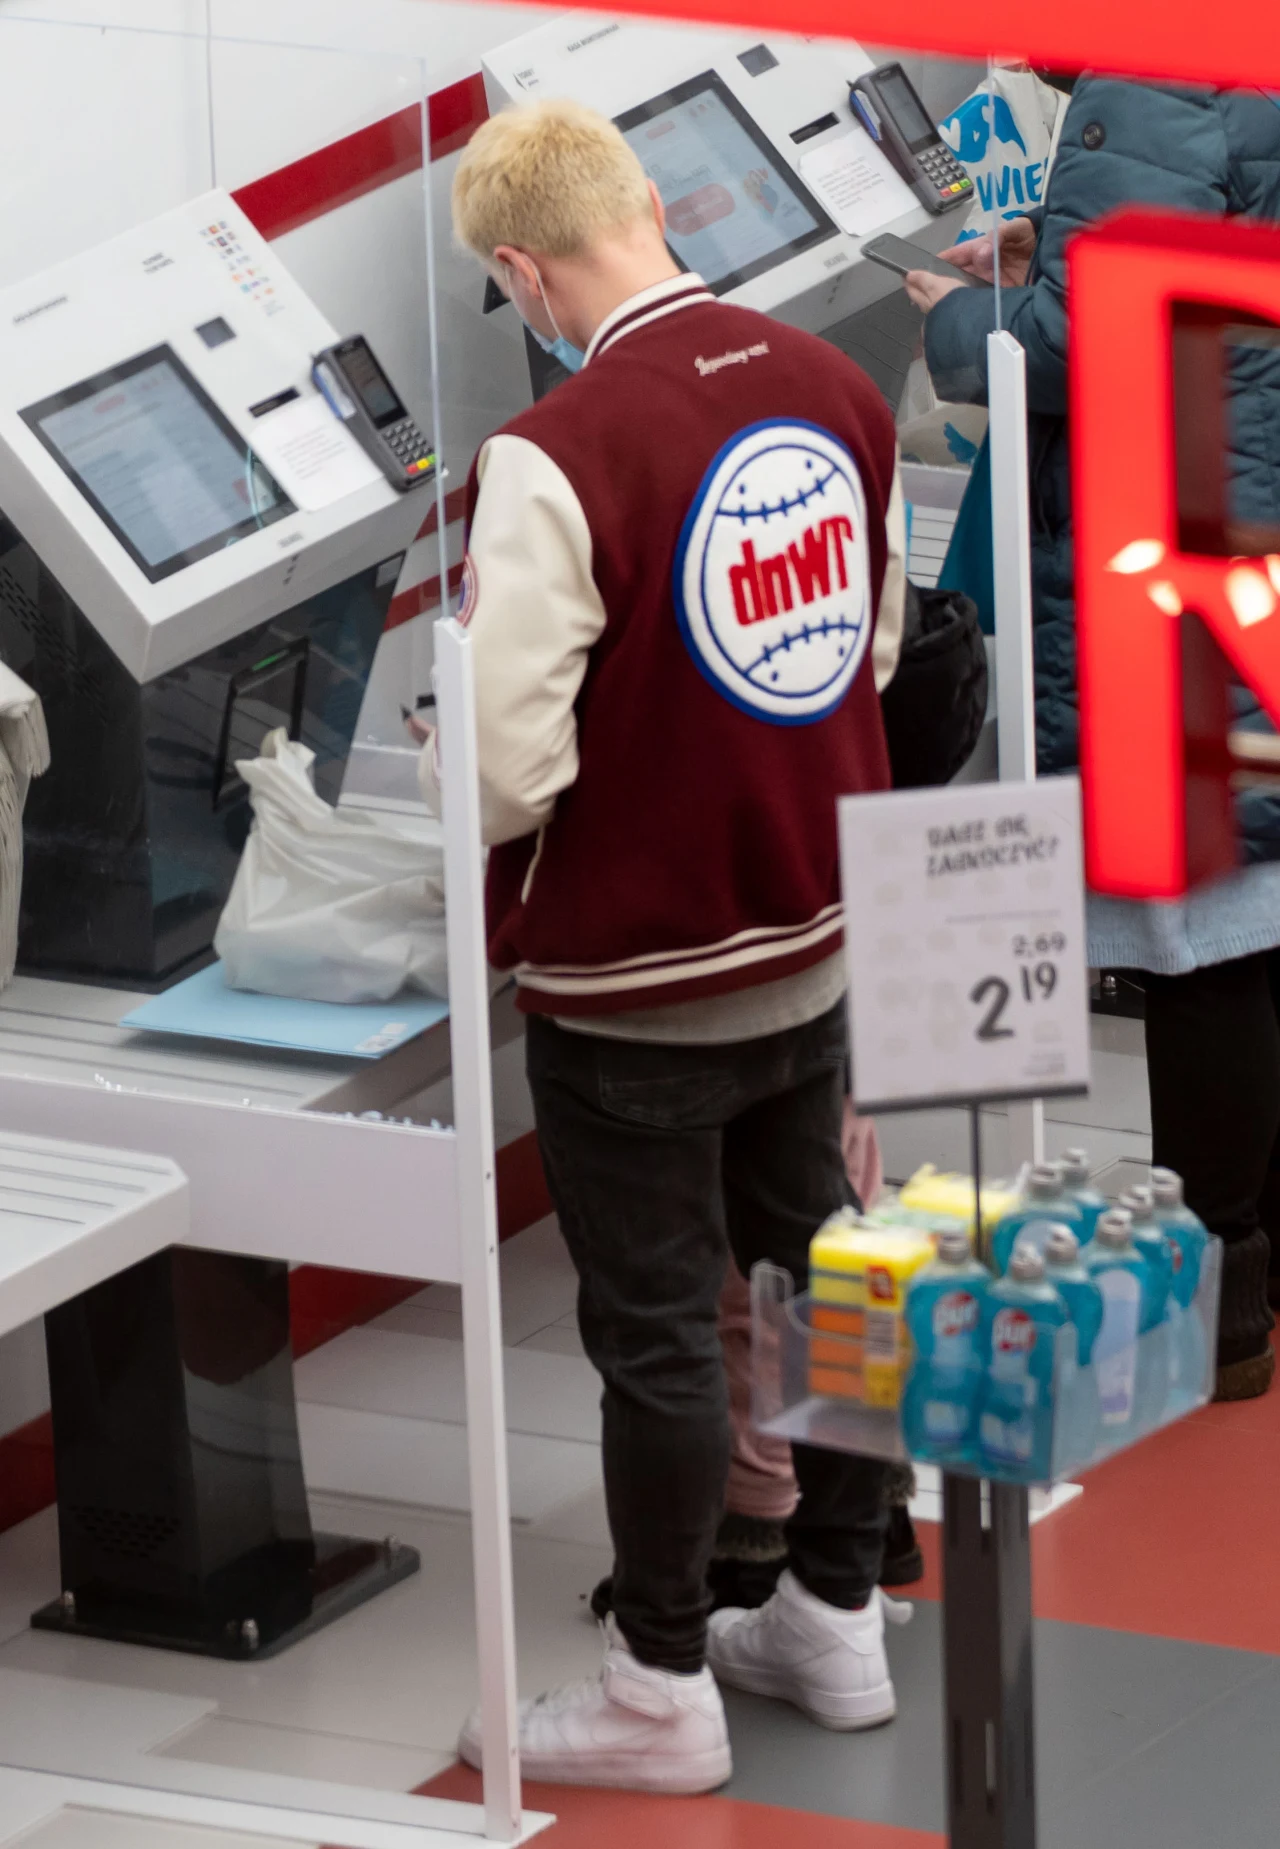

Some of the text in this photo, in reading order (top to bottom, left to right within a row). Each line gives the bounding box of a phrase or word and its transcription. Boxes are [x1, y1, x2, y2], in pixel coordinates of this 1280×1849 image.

[976, 157, 1048, 212] WIE
[969, 960, 1059, 1044] 2 19
